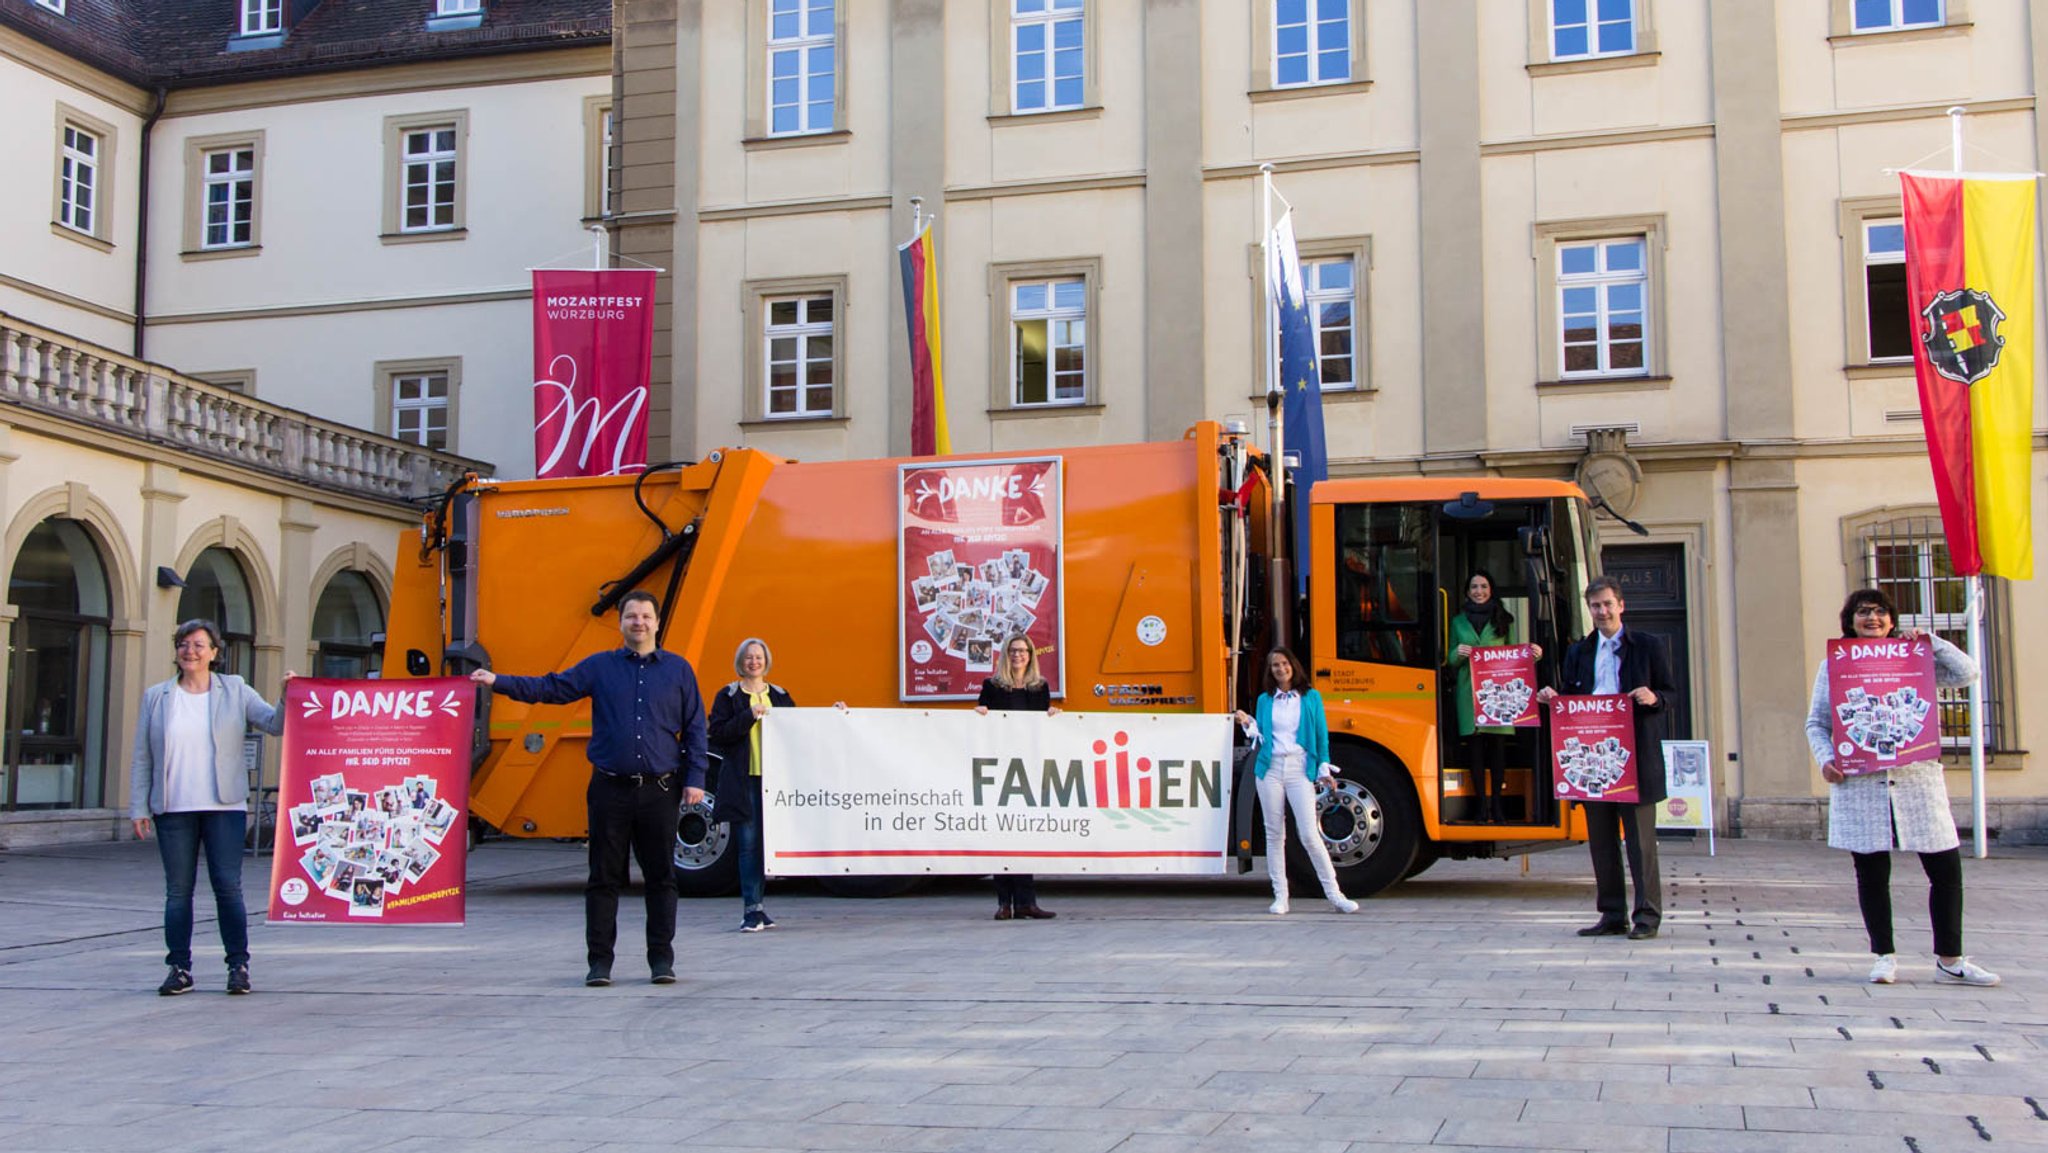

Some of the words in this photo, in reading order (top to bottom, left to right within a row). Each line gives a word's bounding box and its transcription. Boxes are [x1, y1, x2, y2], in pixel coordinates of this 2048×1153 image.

[547, 296, 643, 307] MOZARTFEST
[547, 308, 625, 320] WÜRZBURG
[939, 474, 1023, 503] DANKE
[1484, 648, 1520, 662] DANKE
[1851, 642, 1909, 660] DANKE
[331, 689, 434, 720] DANKE
[1568, 698, 1614, 714] DANKE
[774, 789, 964, 810] Arbeitsgemeinschaft
[864, 811, 883, 831] in
[892, 811, 926, 832] der
[934, 812, 987, 832] Stadt
[996, 812, 1091, 837] Würzburg
